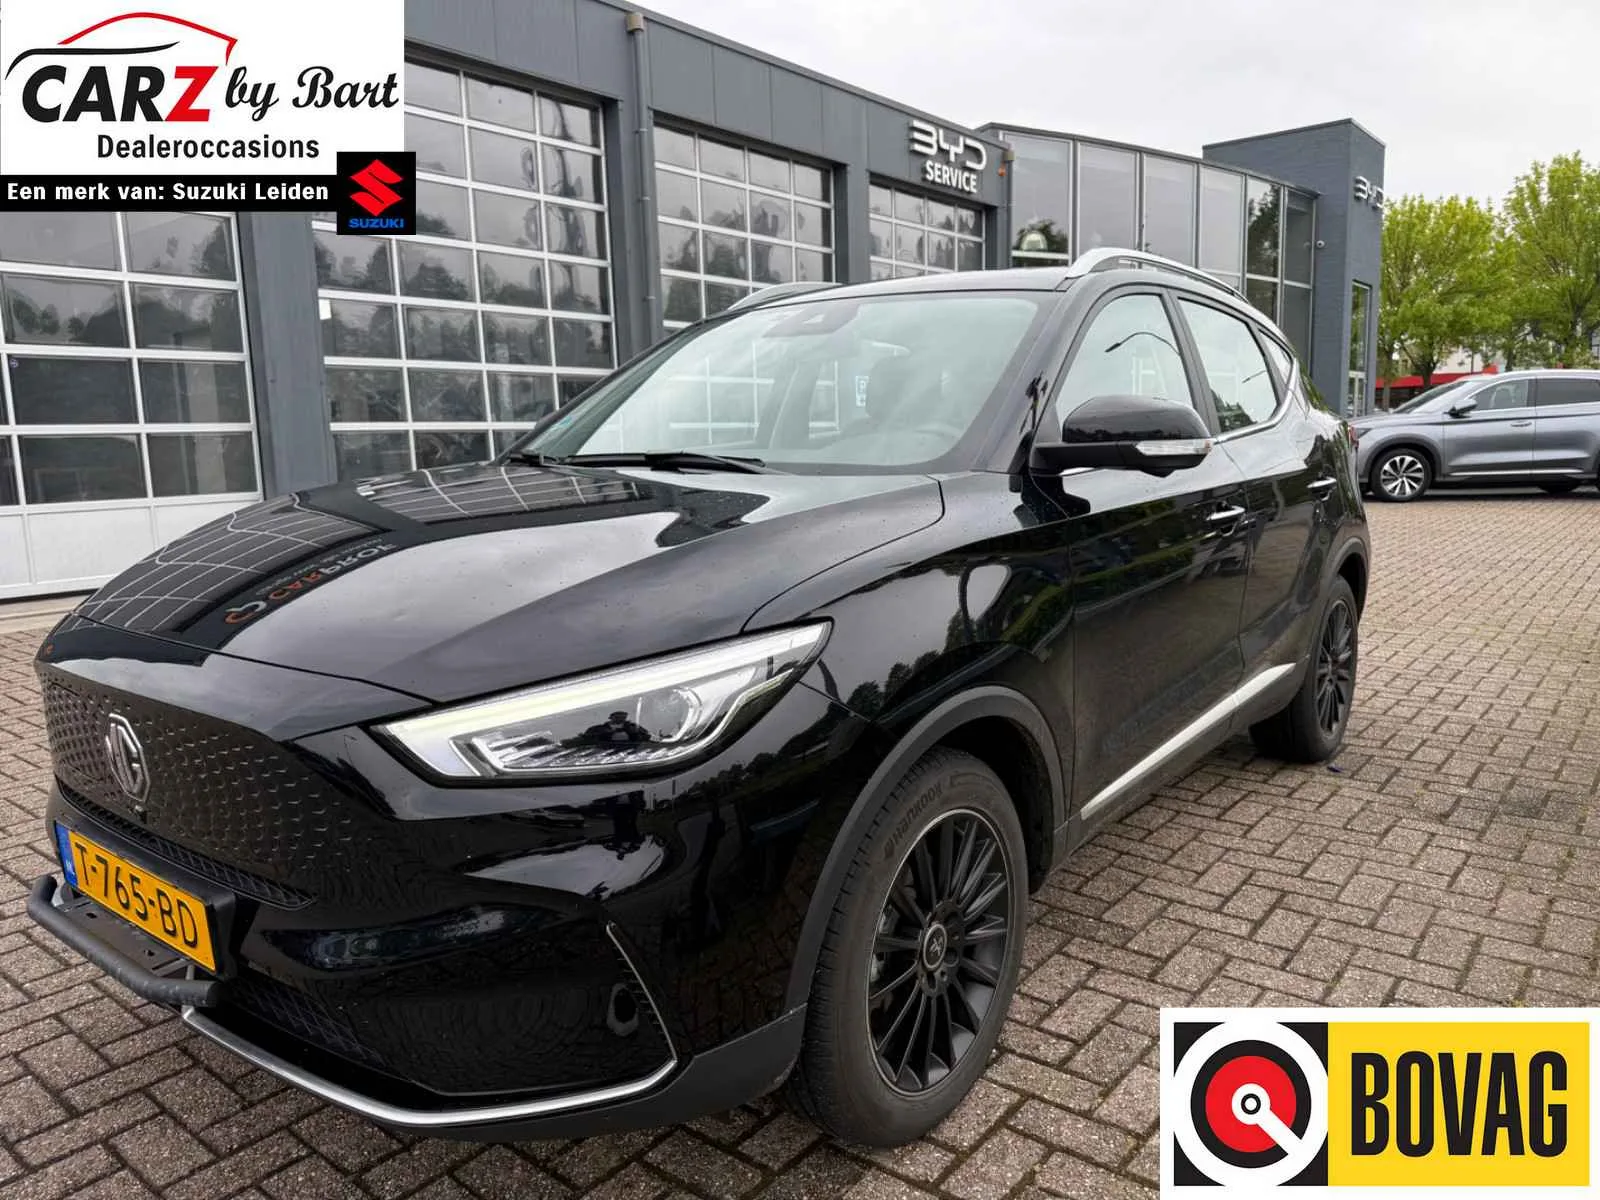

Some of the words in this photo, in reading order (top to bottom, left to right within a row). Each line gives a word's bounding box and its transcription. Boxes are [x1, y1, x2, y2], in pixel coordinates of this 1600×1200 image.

[911, 119, 987, 171] BYD
[925, 159, 978, 193] SERVICE
[74, 841, 199, 949] T-765-BD
